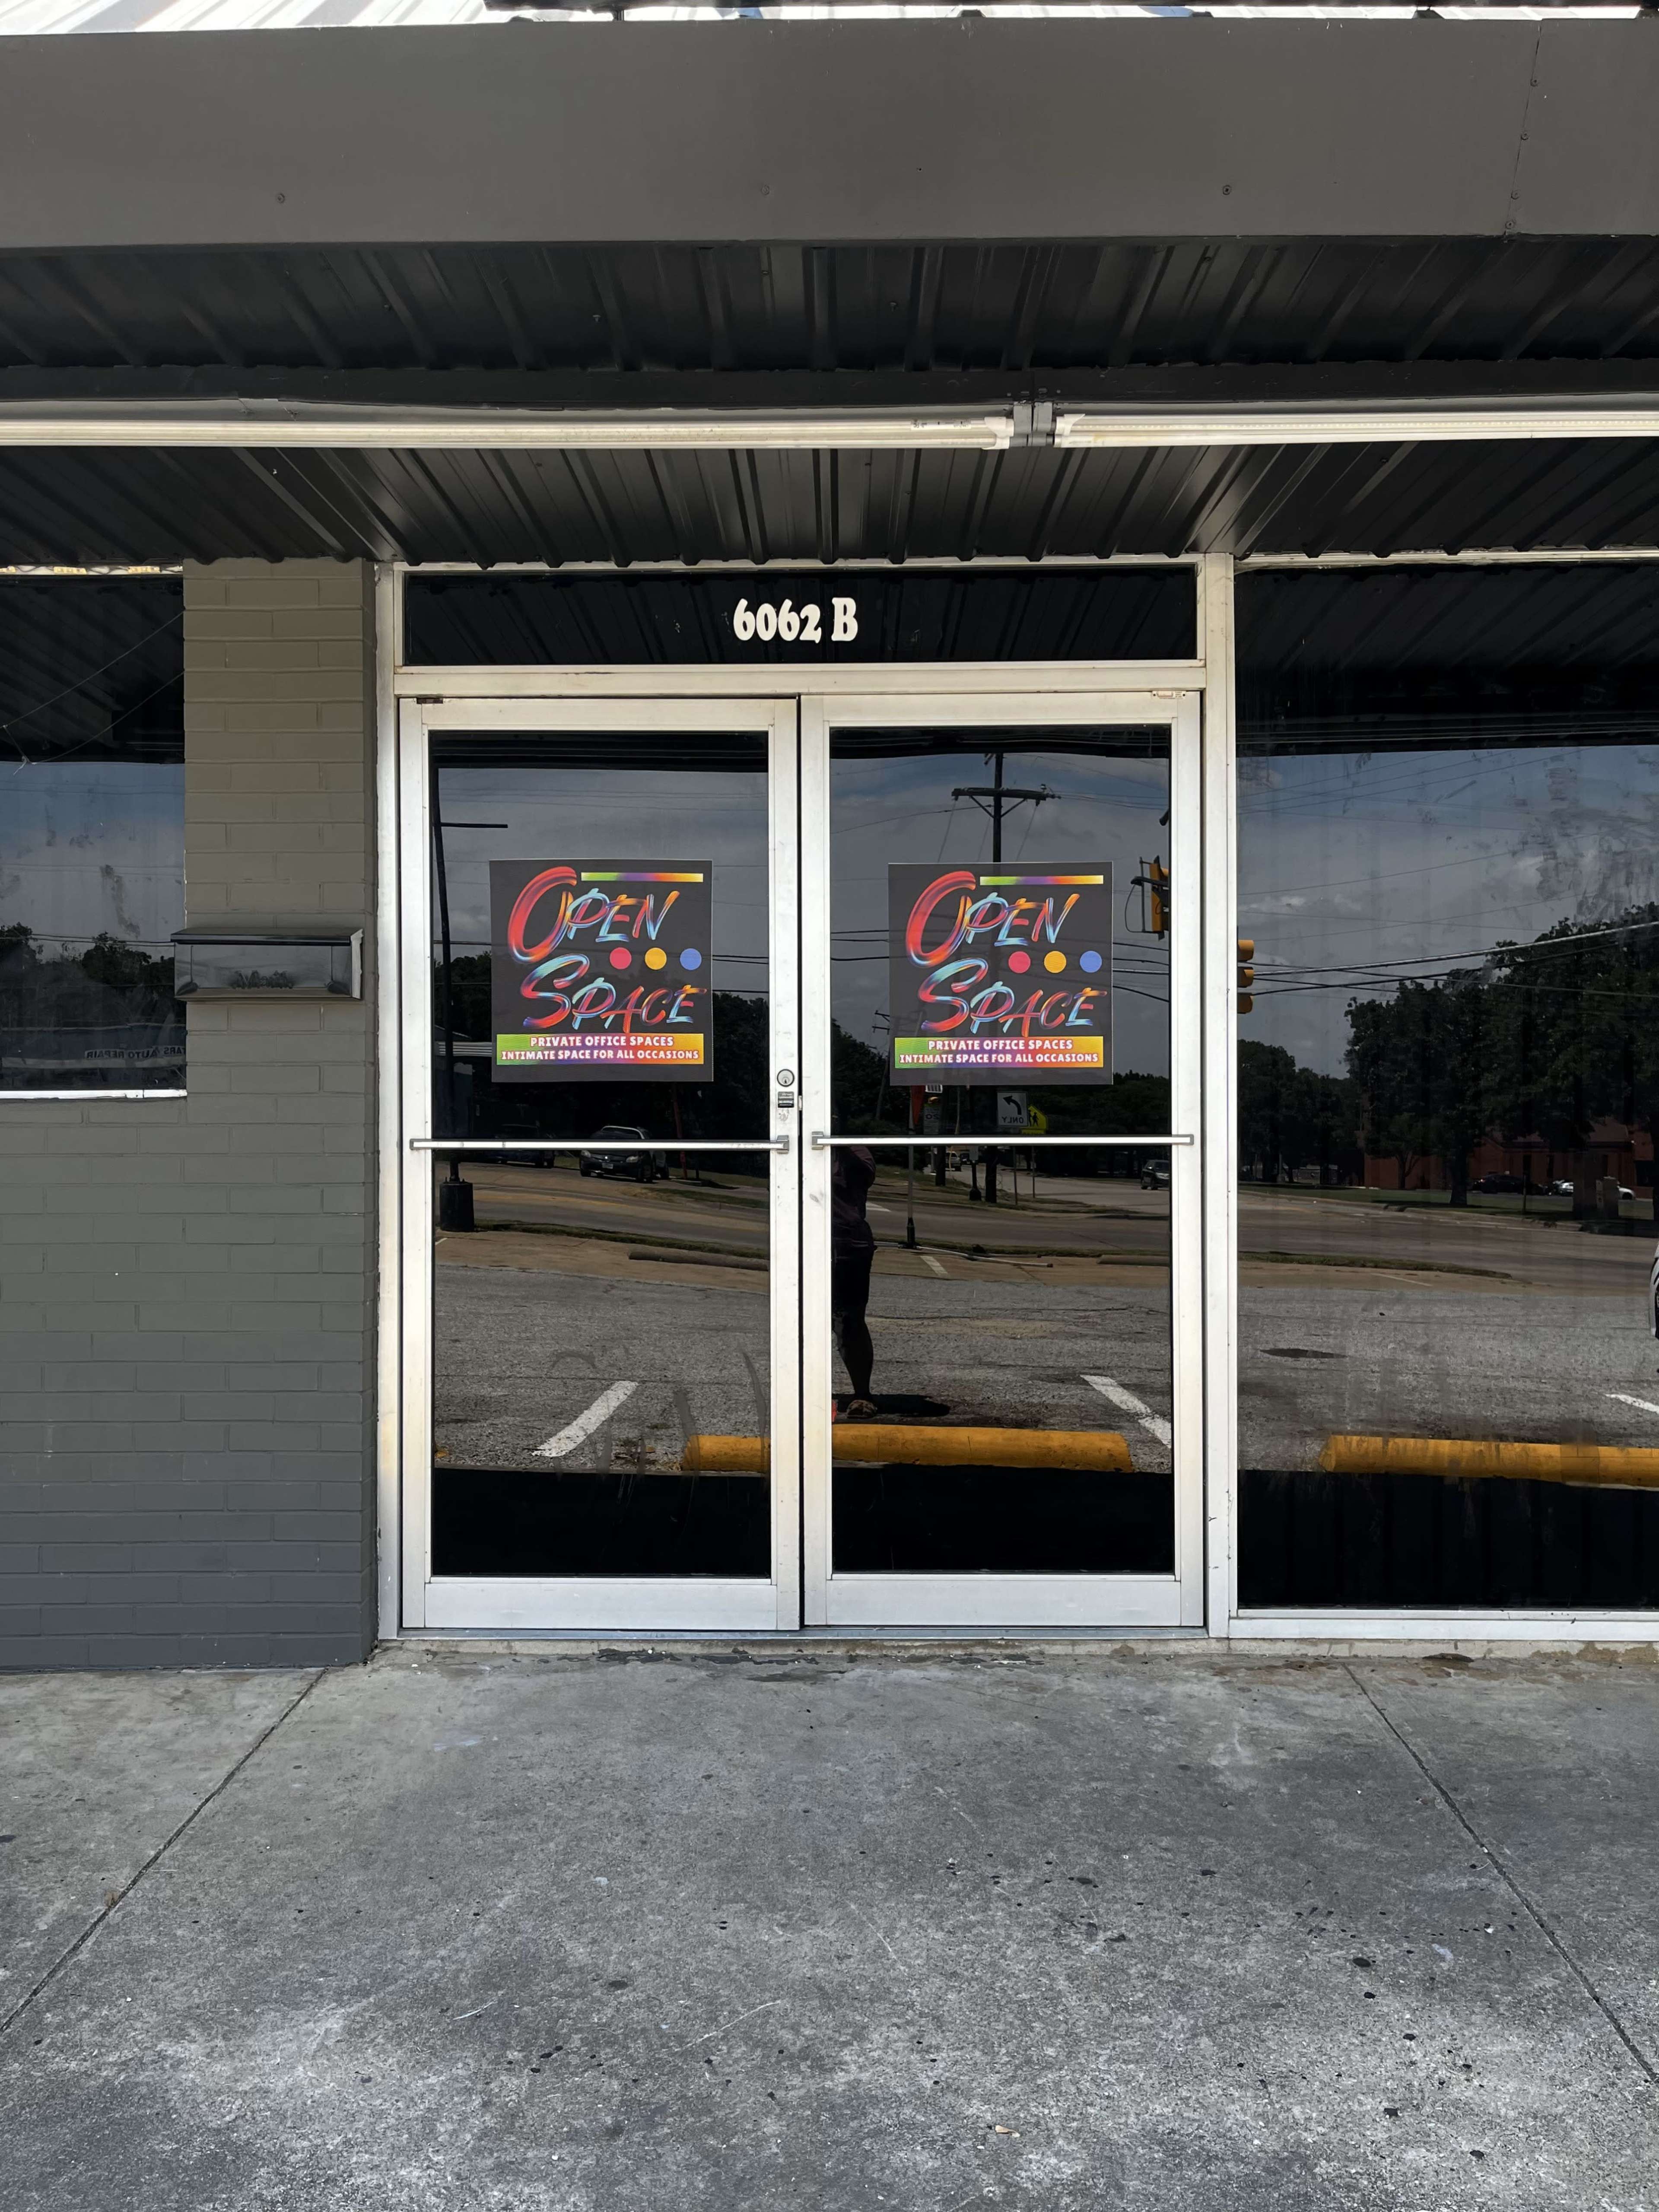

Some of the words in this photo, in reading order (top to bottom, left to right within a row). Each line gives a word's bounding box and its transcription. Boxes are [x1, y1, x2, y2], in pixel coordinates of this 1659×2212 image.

[734, 598, 821, 643] 6062
[831, 597, 858, 641] B
[508, 866, 680, 963] OPEN
[906, 871, 1080, 968] OPEN
[521, 953, 707, 1033] SPACE
[918, 957, 1107, 1037] SPACE
[502, 1051, 555, 1060] INTIMATE
[558, 1050, 591, 1060] SPACE
[593, 1050, 614, 1059] FOR
[617, 1050, 635, 1059] ALL
[638, 1050, 699, 1059] OCCASIONS
[530, 1037, 582, 1046] PRIVATE
[585, 1036, 626, 1046] OFFICE
[630, 1036, 674, 1046] SPACES
[899, 1054, 953, 1063] INTIMATE
[956, 1054, 989, 1063] SPACE
[992, 1054, 1012, 1063] FOR
[1015, 1054, 1033, 1062] ALL
[1036, 1054, 1099, 1062] OCCASIONS
[928, 1040, 980, 1050] PRIVATE
[983, 1040, 1025, 1049] OFFICE
[1028, 1040, 1073, 1049] SPACES
